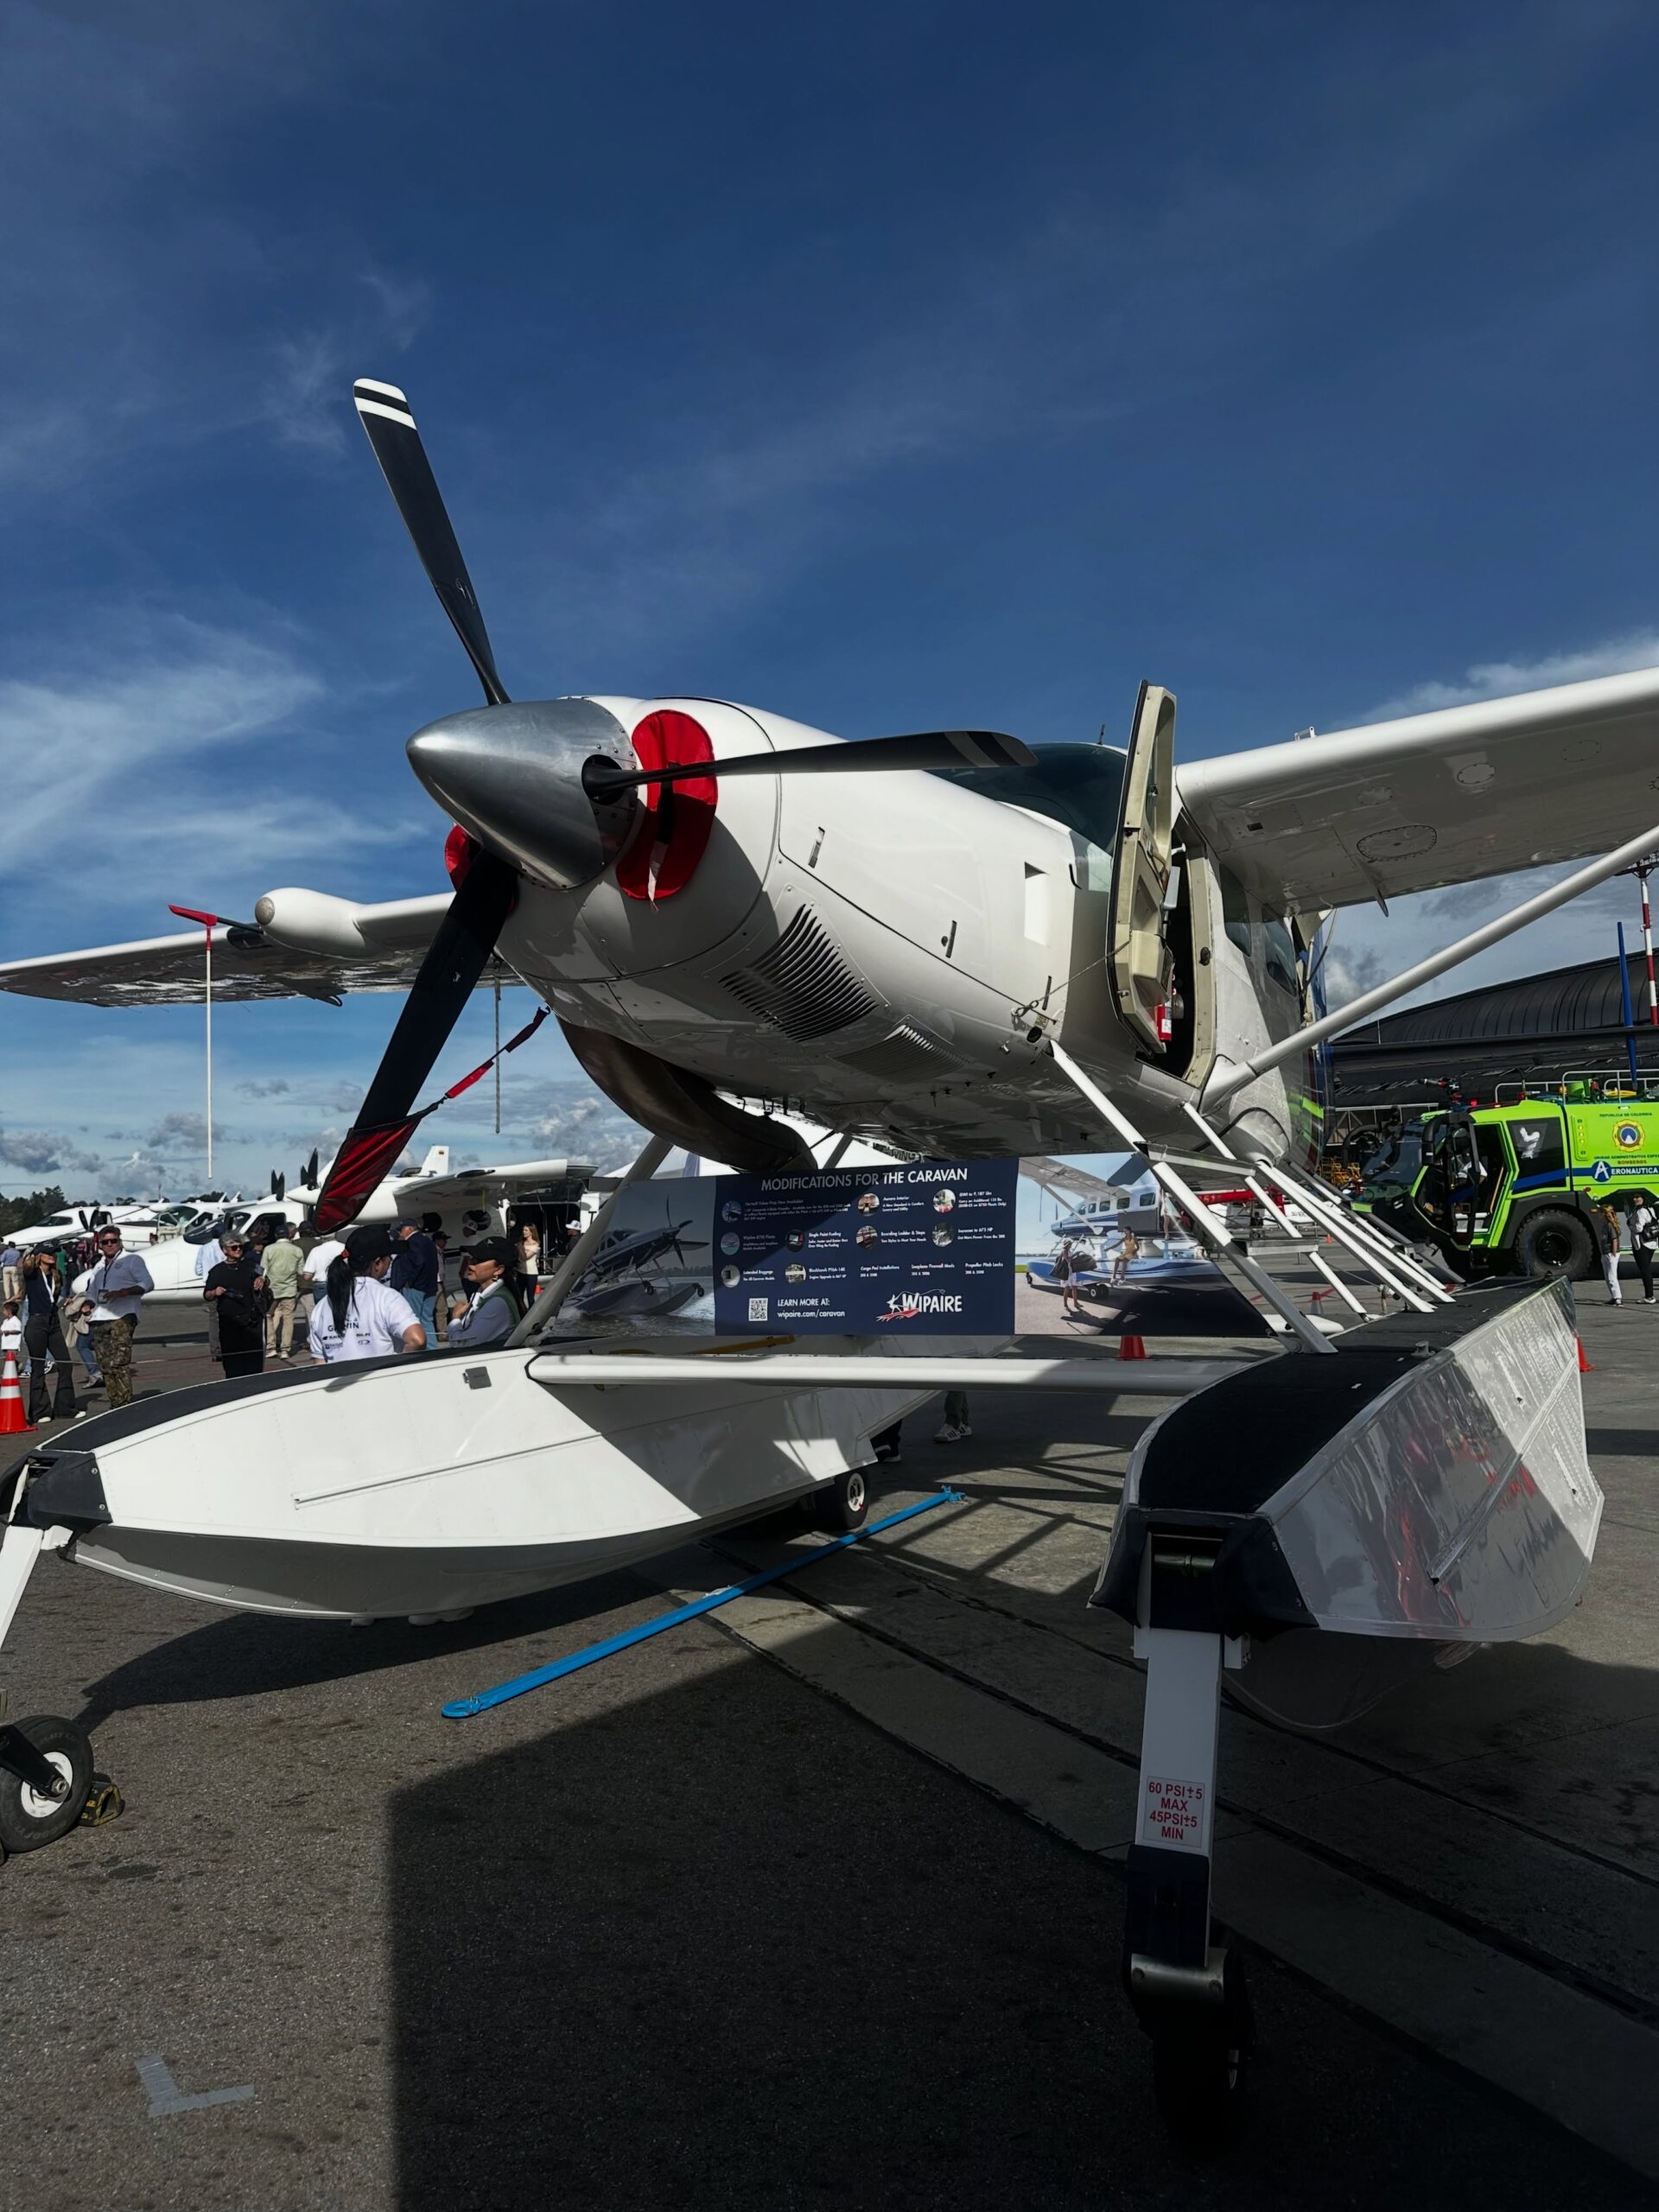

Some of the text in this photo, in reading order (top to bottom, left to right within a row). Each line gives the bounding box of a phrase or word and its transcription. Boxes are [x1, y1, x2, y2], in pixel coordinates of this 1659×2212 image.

[760, 1168, 968, 1192] MODIFICATIONS FOR THE CARAVAN
[902, 1293, 963, 1313] WIPAIRE
[778, 1308, 845, 1319] wipaire.com/caravan
[1148, 1782, 1161, 1794] 60
[1160, 1797, 1189, 1811] MAX
[1161, 1826, 1184, 1840] MIN
